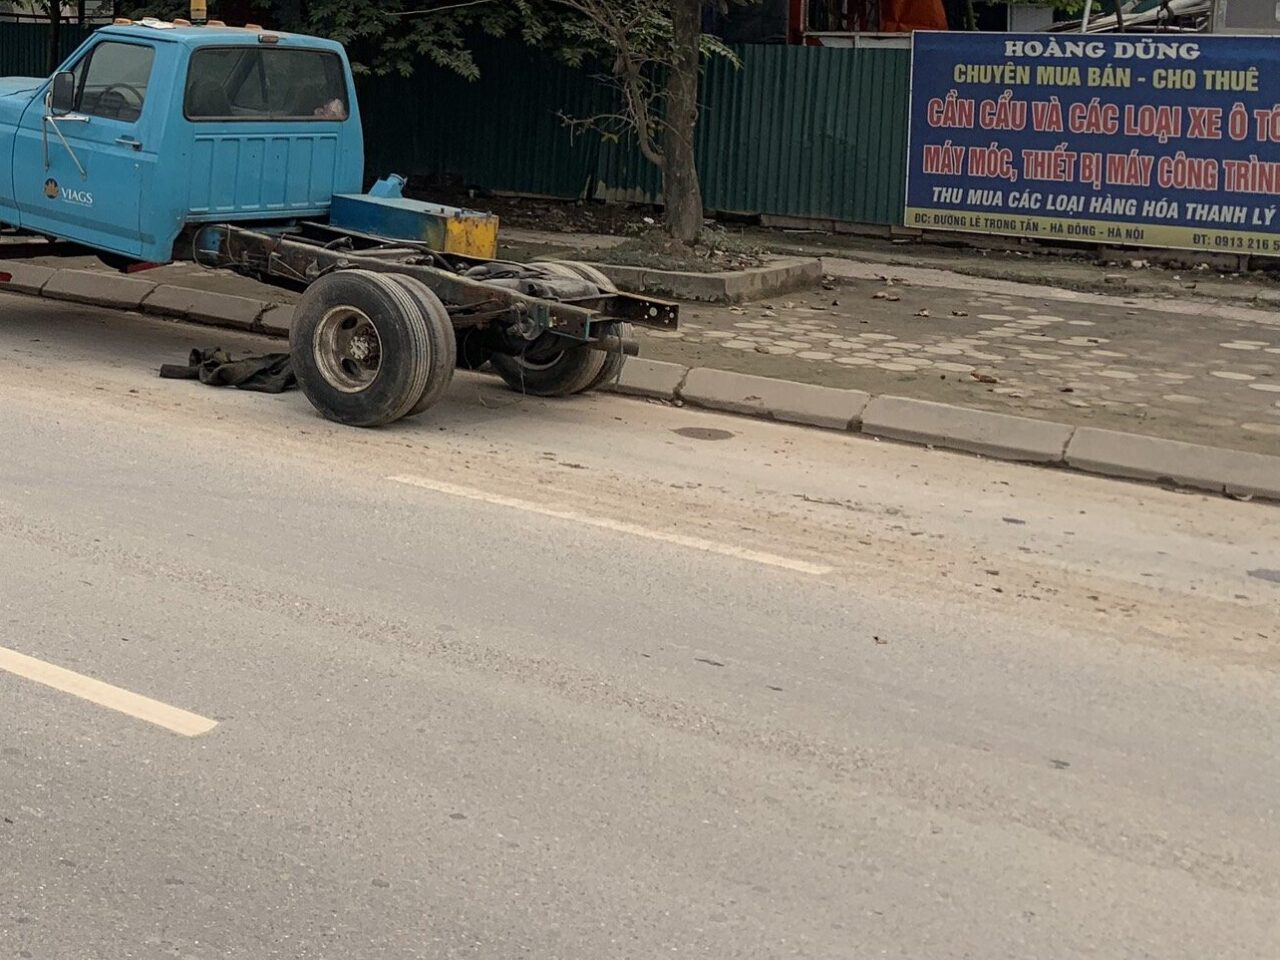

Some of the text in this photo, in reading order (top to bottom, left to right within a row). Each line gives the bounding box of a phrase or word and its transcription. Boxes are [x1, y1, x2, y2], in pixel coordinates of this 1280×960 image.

[1004, 37, 1201, 60] HOÀNG DŨNG
[953, 61, 1030, 85] CHUYÊN
[1036, 65, 1081, 86] MUA
[1087, 63, 1131, 88] BÁN
[1152, 68, 1196, 90] CHO
[1203, 67, 1259, 92] THUÊ
[927, 89, 975, 128] CẦN
[979, 89, 1027, 131] CẨU
[1031, 95, 1064, 132] VÀ
[1068, 97, 1119, 135] CÁC
[1124, 104, 1182, 144] LOẠI
[1186, 106, 1222, 139] XE
[1228, 102, 1248, 141] Ô
[922, 140, 965, 175] MÁY
[968, 142, 1018, 182] MÓC,
[1022, 142, 1077, 182] THIẾT
[1079, 150, 1102, 190] BỊ
[1105, 149, 1154, 187] MÁY
[1158, 151, 1218, 191] CÔNG
[61, 187, 93, 204] VIAGS
[932, 186, 1277, 226] THU MUA CÁC LOẠI HÀNG HÓA THANH LÝ
[969, 215, 982, 227] LÊ
[1125, 226, 1144, 242] NỘI
[1192, 233, 1210, 245] ĐT:
[1215, 235, 1244, 248] 0913
[1247, 238, 1269, 250] 216
